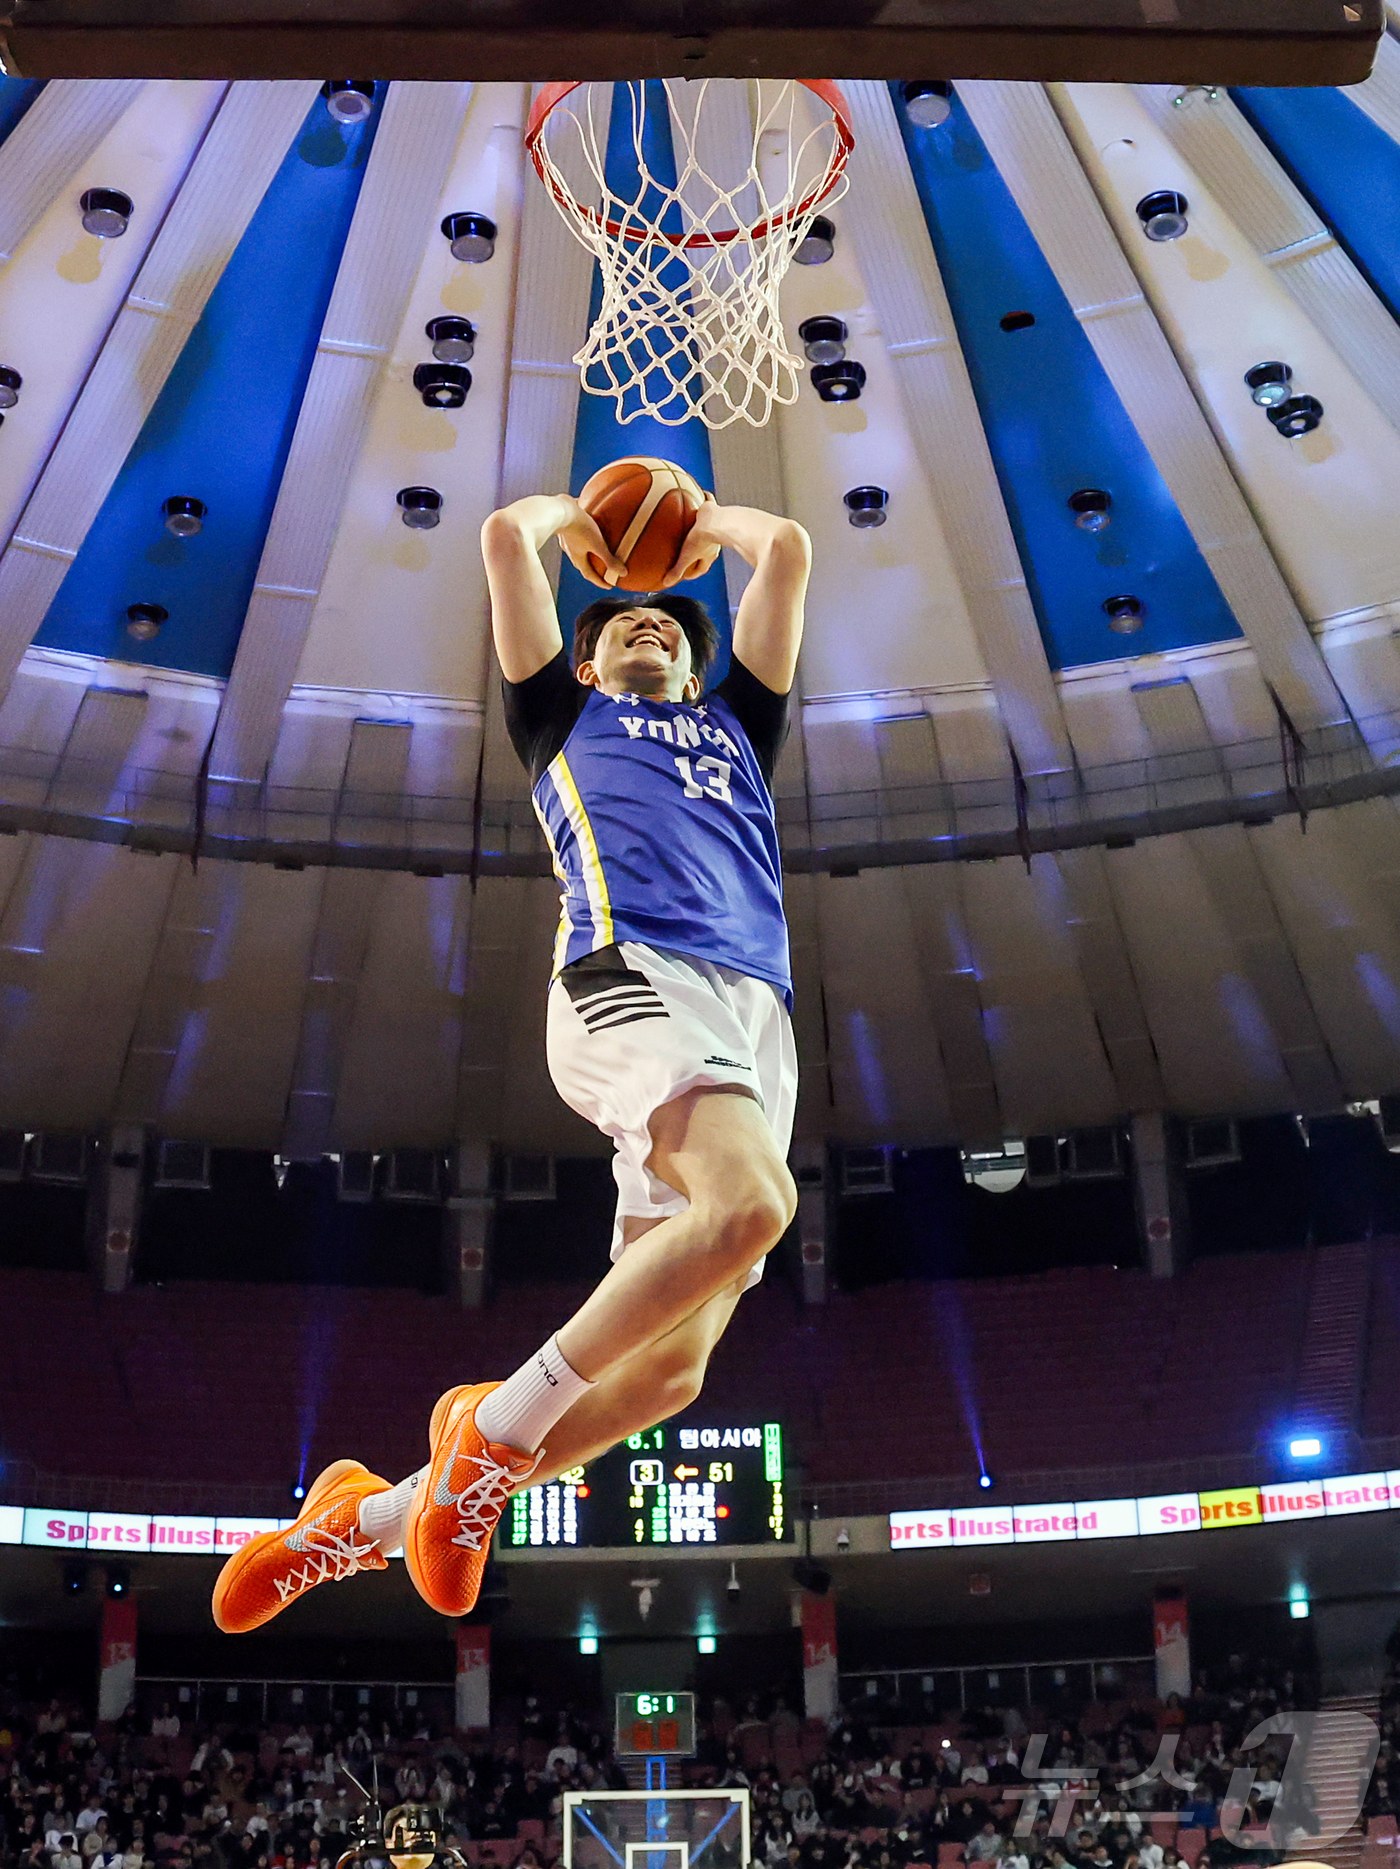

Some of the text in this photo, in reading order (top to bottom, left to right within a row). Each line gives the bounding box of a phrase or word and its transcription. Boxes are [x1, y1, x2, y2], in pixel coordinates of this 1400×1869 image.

[674, 755, 733, 805] 13
[639, 1463, 655, 1482] 3
[708, 1461, 733, 1482] 51
[949, 1512, 1098, 1538] Illustrated
[1160, 1501, 1253, 1525] Sports
[47, 1520, 260, 1546] Sports Illustra
